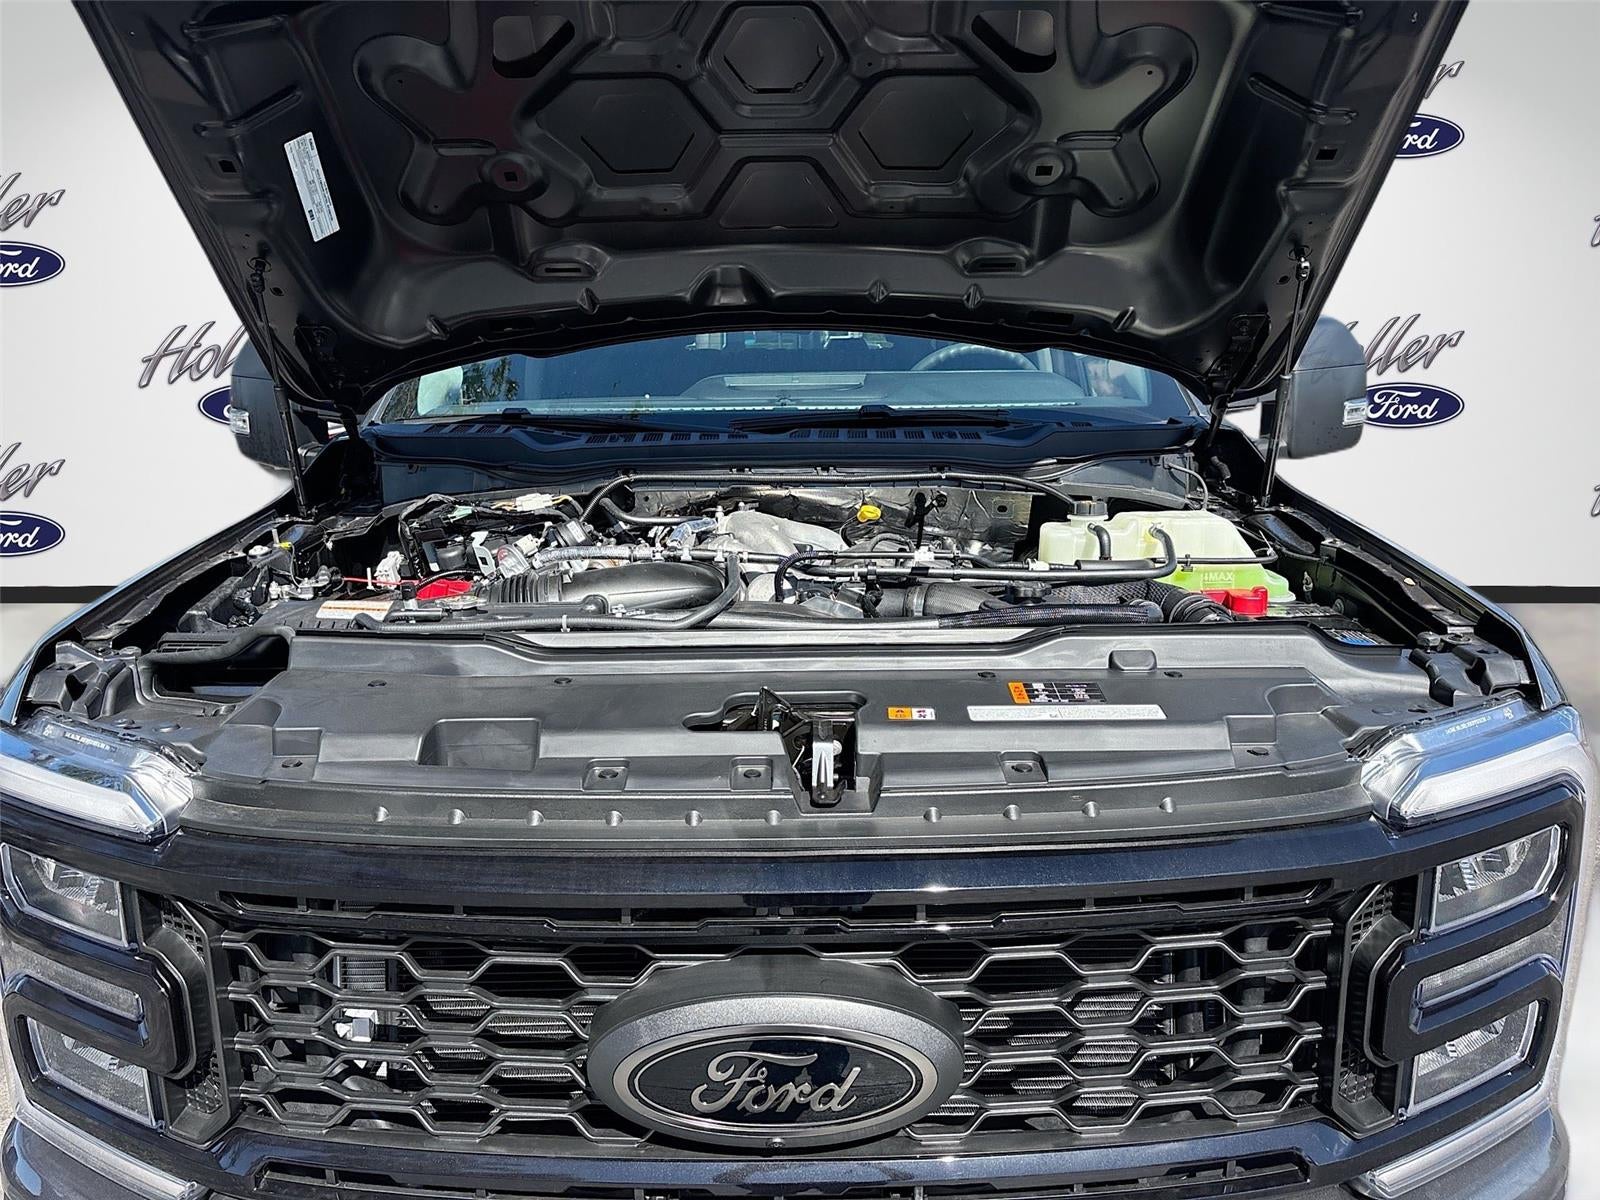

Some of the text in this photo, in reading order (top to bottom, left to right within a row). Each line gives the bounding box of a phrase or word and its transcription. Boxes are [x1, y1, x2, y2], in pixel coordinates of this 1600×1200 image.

[138, 320, 247, 389] Hol
[1346, 313, 1465, 376] ller
[1367, 389, 1440, 419] Ford
[690, 1050, 861, 1113] Ford
